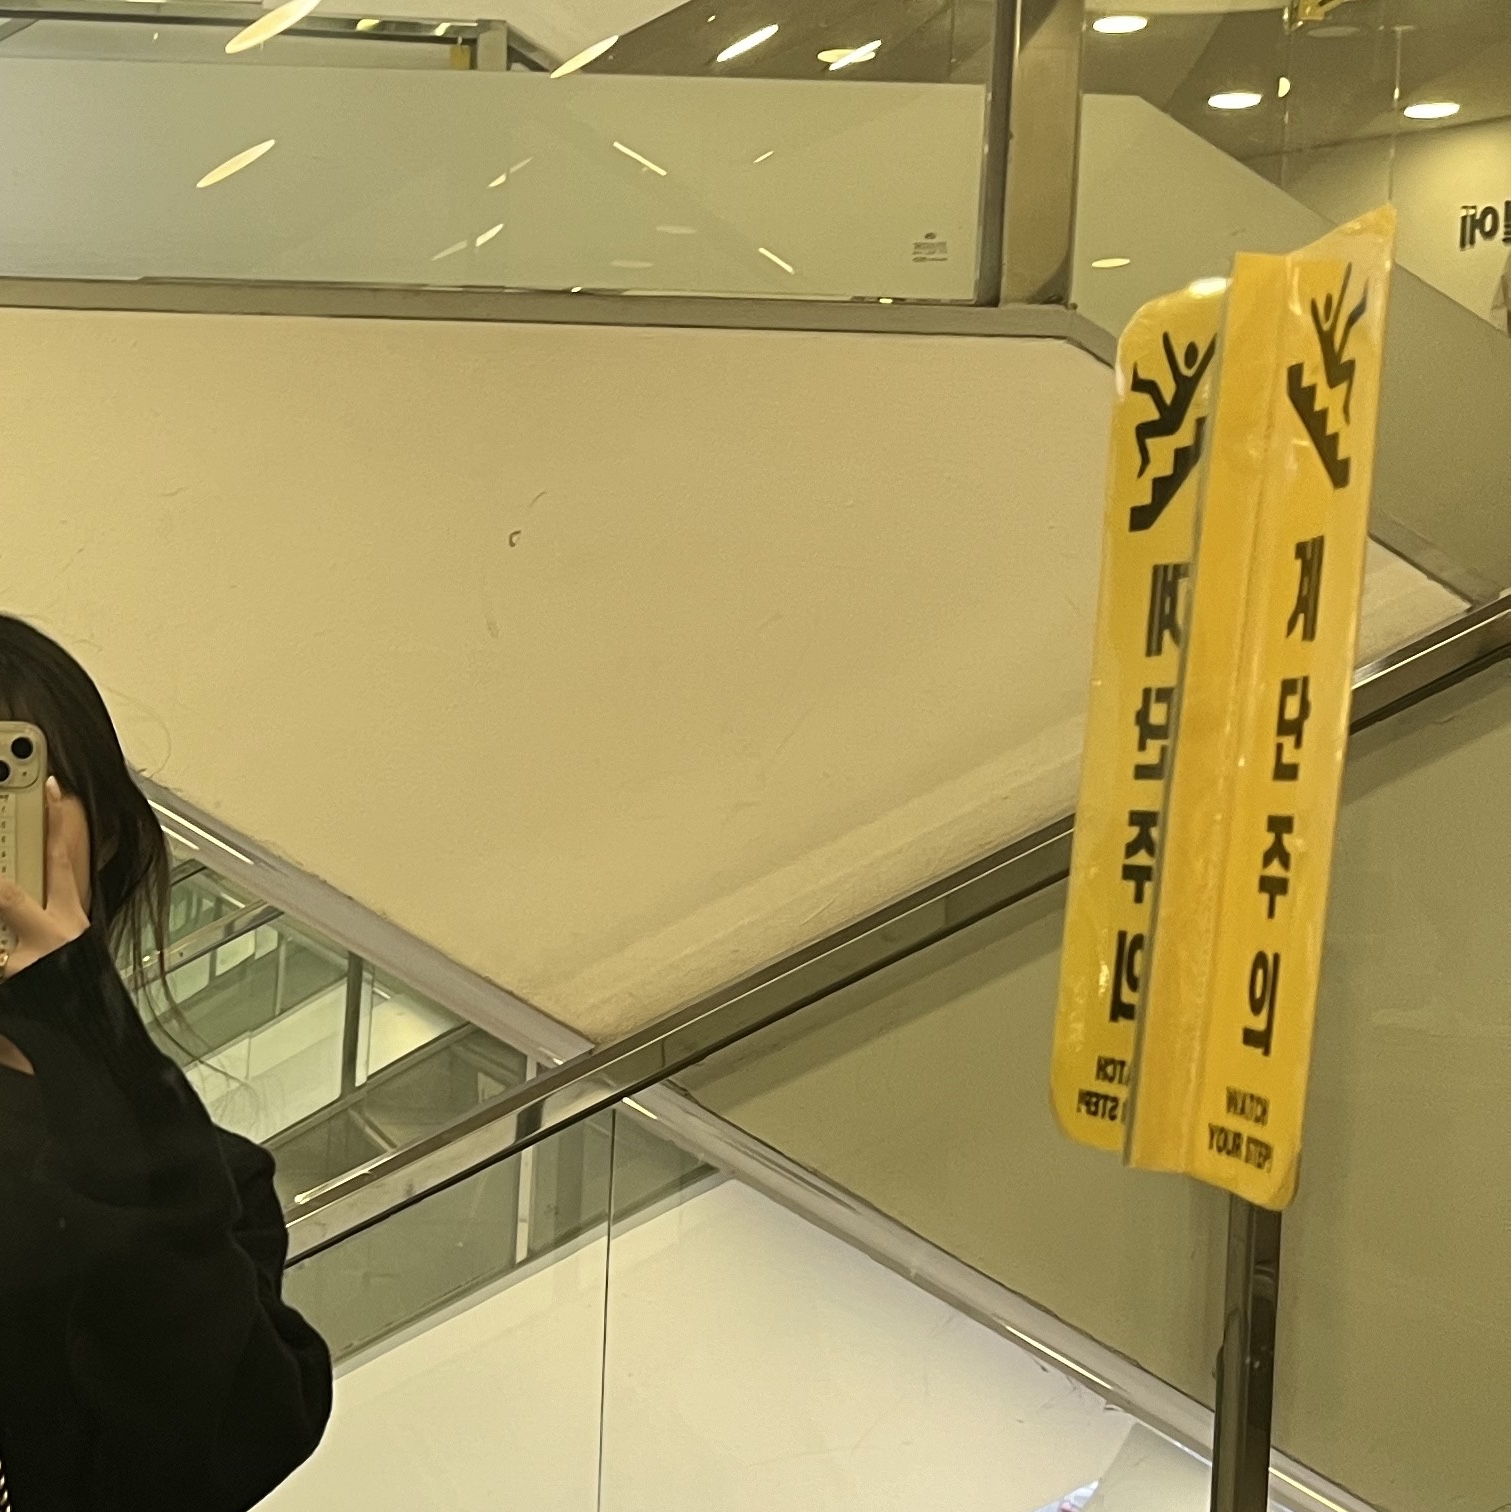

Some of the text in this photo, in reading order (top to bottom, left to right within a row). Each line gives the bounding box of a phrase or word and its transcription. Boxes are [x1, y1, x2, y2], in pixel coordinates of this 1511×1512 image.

[1243, 535, 1324, 1057] 계단주의
[1226, 1086, 1271, 1126] WATCH
[1208, 1123, 1244, 1159] YOUR
